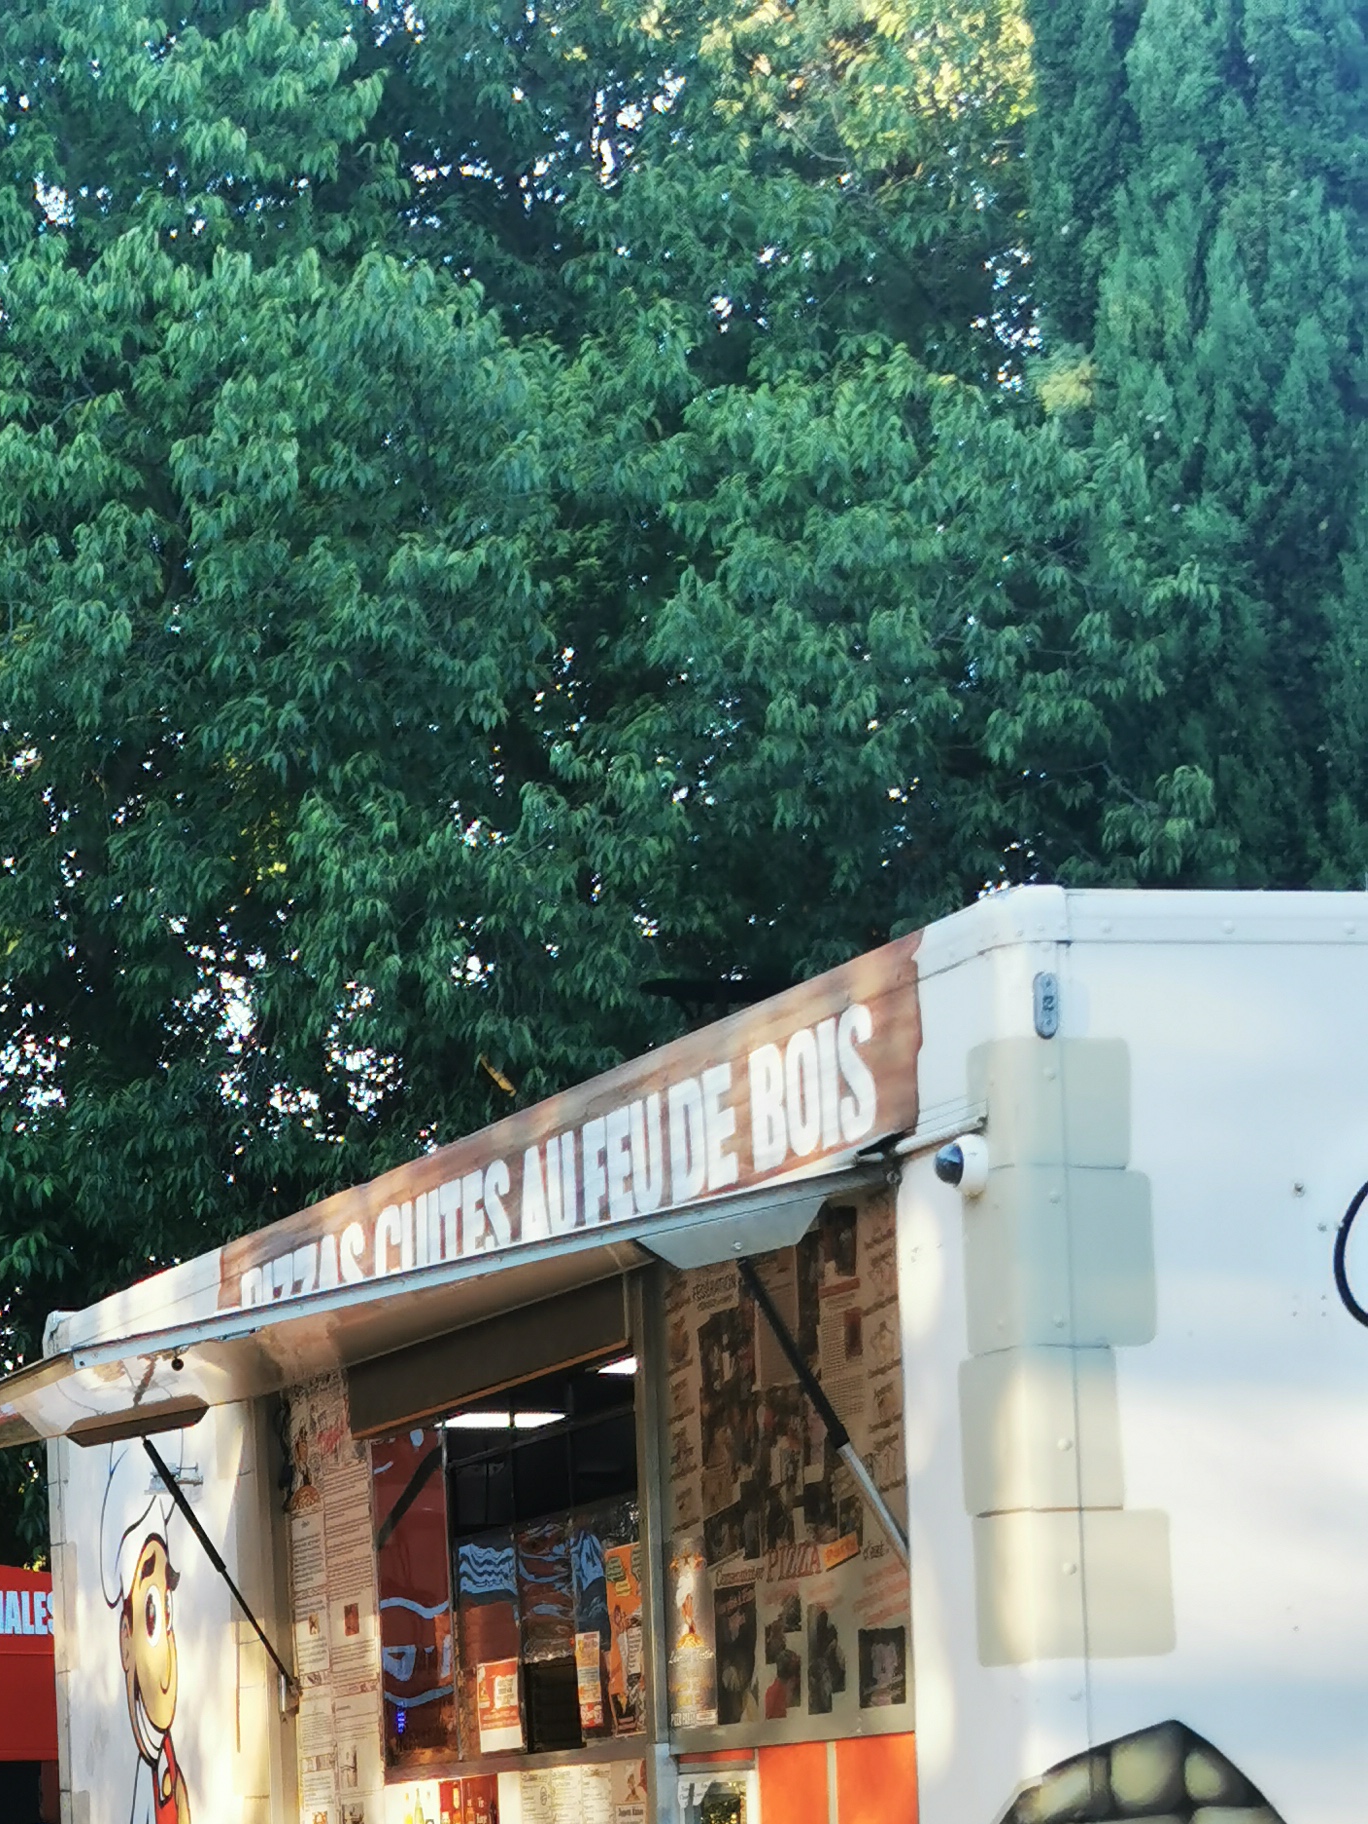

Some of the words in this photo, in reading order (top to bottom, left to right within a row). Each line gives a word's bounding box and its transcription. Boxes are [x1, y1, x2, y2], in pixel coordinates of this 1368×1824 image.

[241, 1222, 366, 1308] PIZZAS
[374, 1159, 512, 1277] CUITES
[521, 1128, 578, 1243] AU
[583, 1091, 664, 1226] FEU
[668, 1062, 739, 1207] DE
[749, 1003, 877, 1173] BOIS
